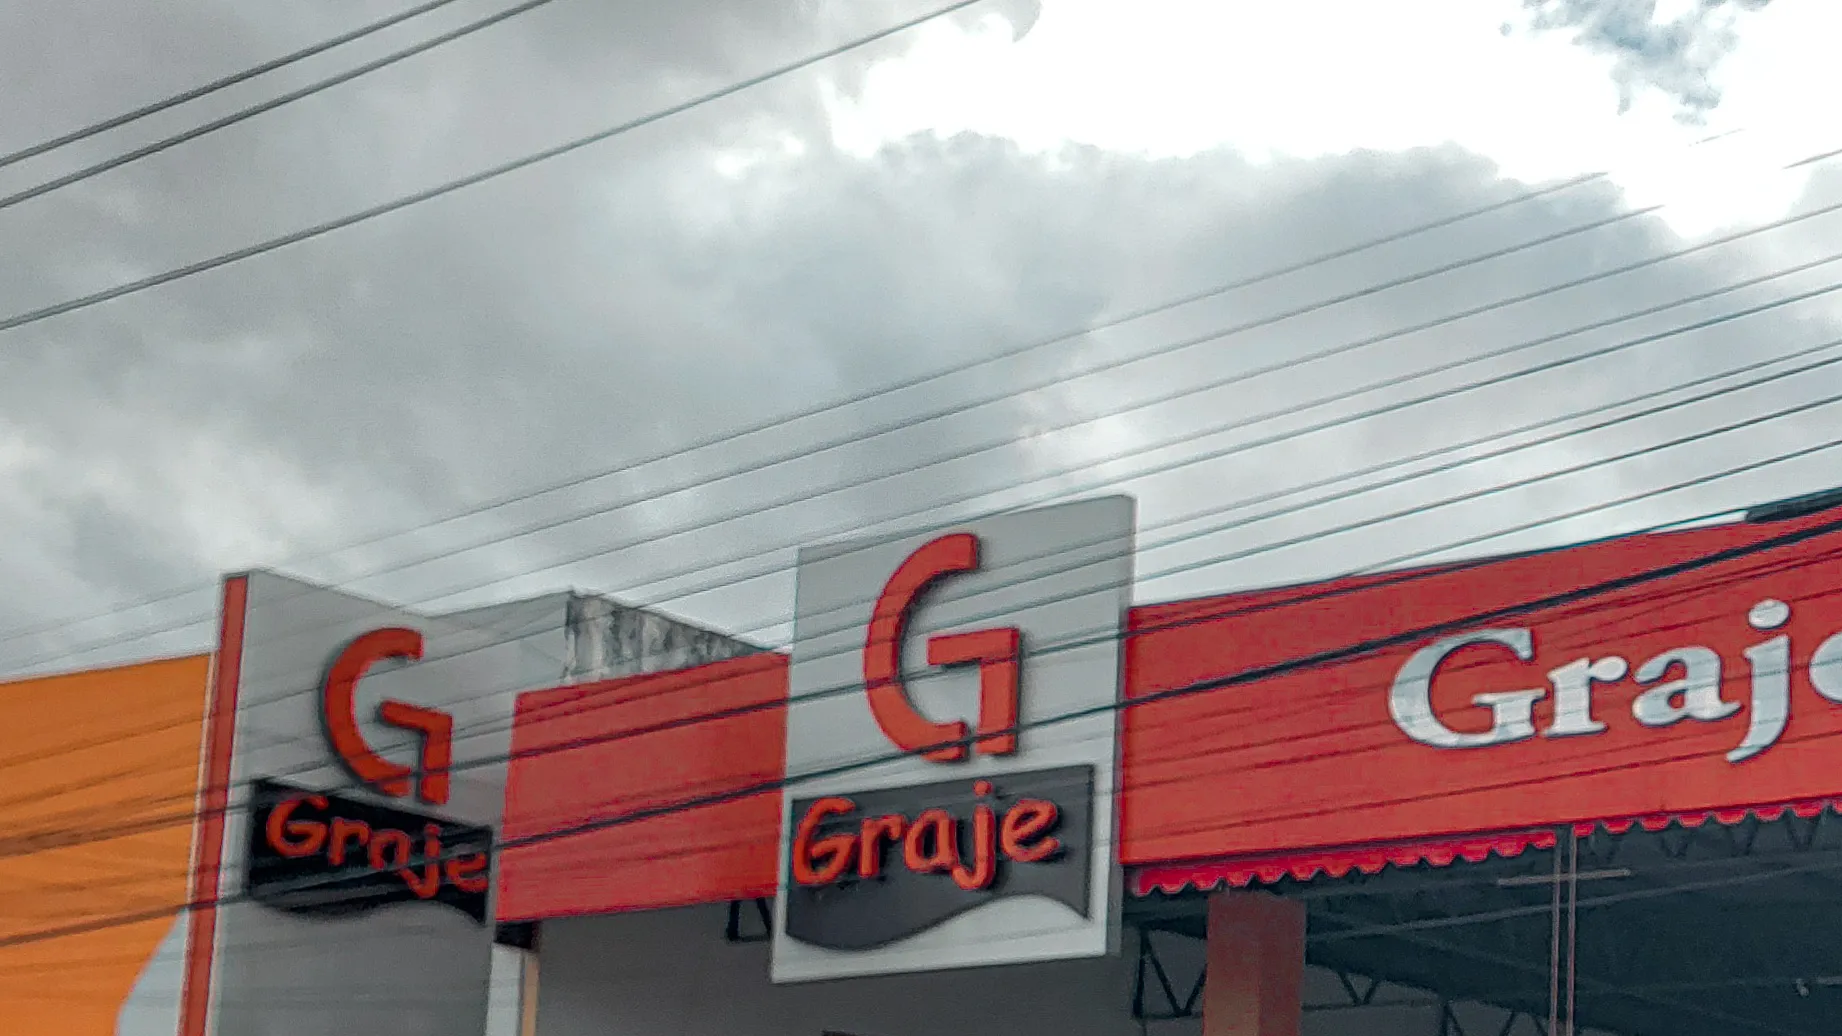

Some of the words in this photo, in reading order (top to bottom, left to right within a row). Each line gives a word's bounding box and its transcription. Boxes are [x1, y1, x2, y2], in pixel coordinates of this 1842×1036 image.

[324, 626, 453, 806] G
[863, 532, 1020, 763] G
[266, 795, 489, 899] Graje
[793, 780, 1060, 891] Graje
